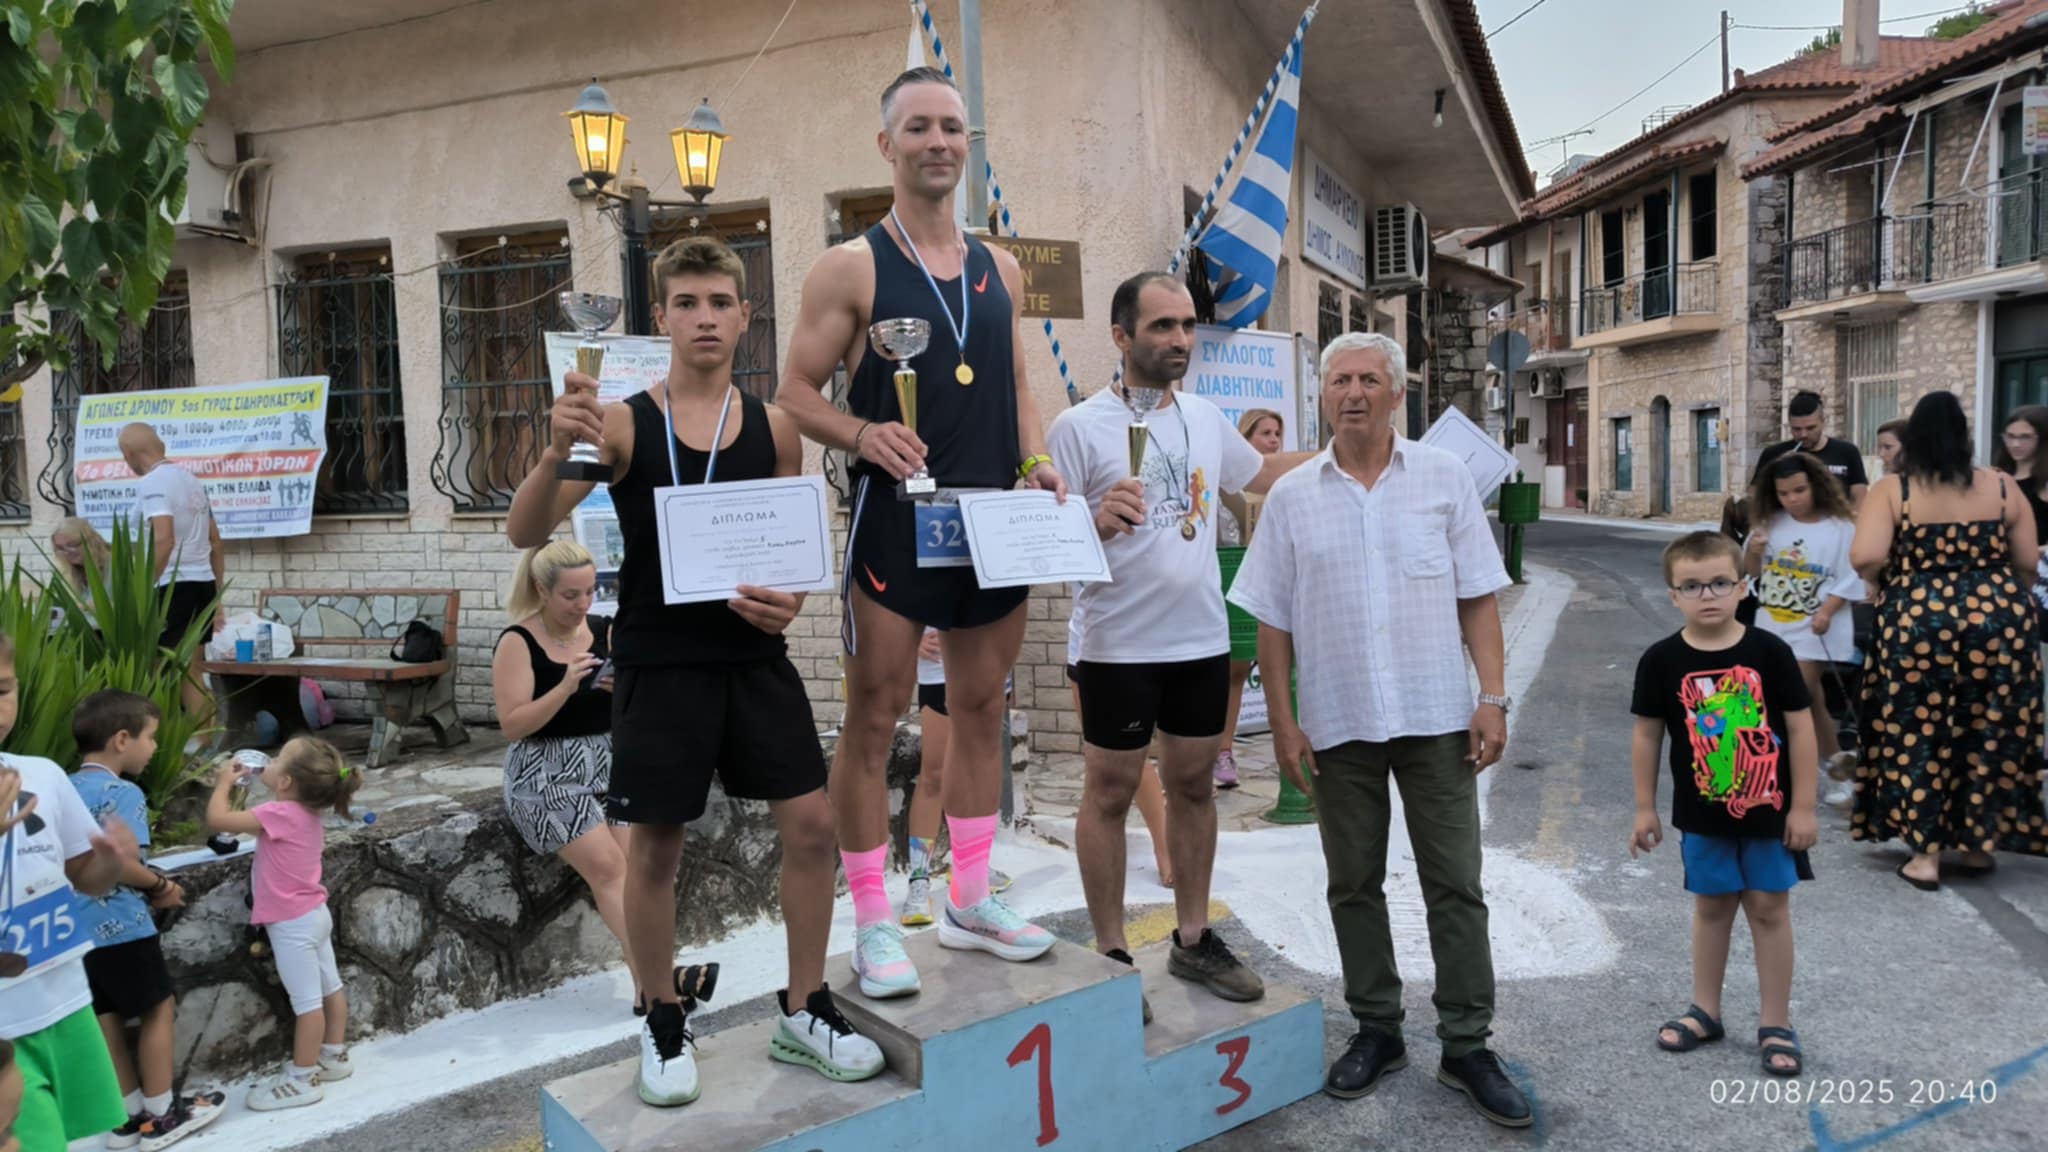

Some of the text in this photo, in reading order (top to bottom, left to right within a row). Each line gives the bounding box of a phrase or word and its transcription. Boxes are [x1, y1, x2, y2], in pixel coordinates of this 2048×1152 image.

[1000, 243, 1062, 264] ΟΥΜΕ
[1202, 340, 1276, 367] ΣΥΛΛΟΓΟΣ
[1195, 372, 1284, 399] ΔΙΑΒΗΤΙΚΩΝ
[85, 400, 128, 419] ΑΓΩΝΕΣ
[128, 399, 175, 416] ΔΡΟΜΟΥ
[201, 397, 232, 412] ΓΥΡΟΣ
[712, 510, 777, 525] ΔΙΠΛΩΜΑ
[1009, 514, 1061, 525] ΔΙΠΛΩΜΑ
[927, 519, 968, 547] 32
[1006, 1023, 1059, 1147] 1
[1215, 1036, 1252, 1116] 3
